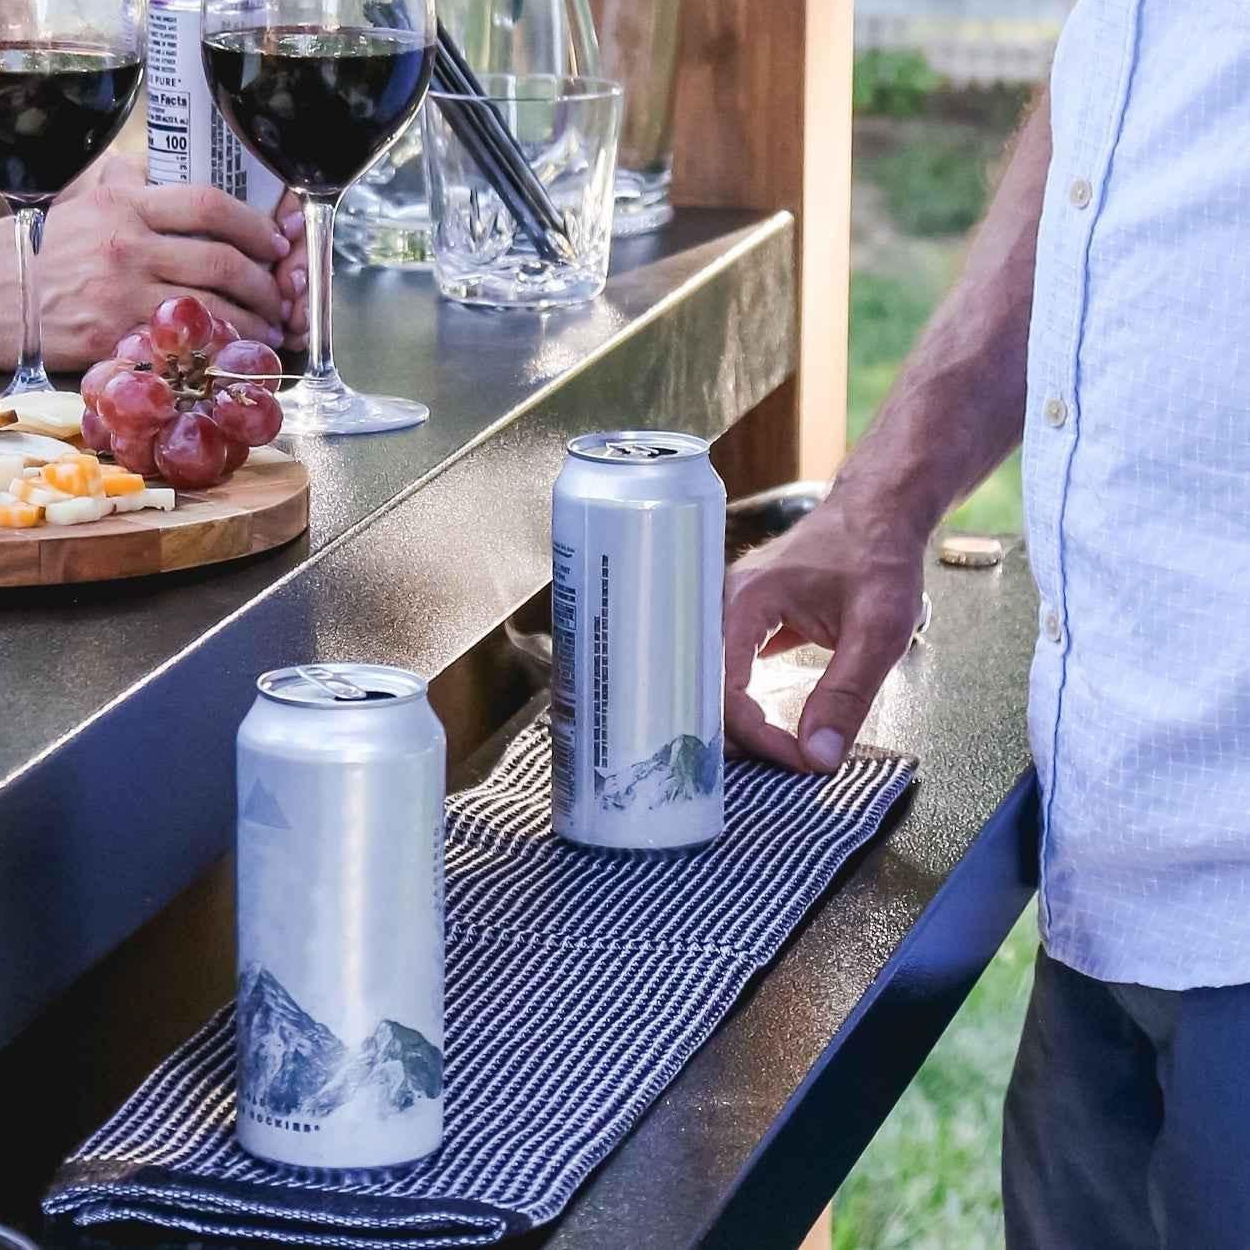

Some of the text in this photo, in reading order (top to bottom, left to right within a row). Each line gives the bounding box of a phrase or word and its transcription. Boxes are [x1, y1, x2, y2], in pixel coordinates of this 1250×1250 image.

[154, 75, 177, 88] PURE
[160, 93, 187, 108] Facts
[165, 135, 187, 150] 100
